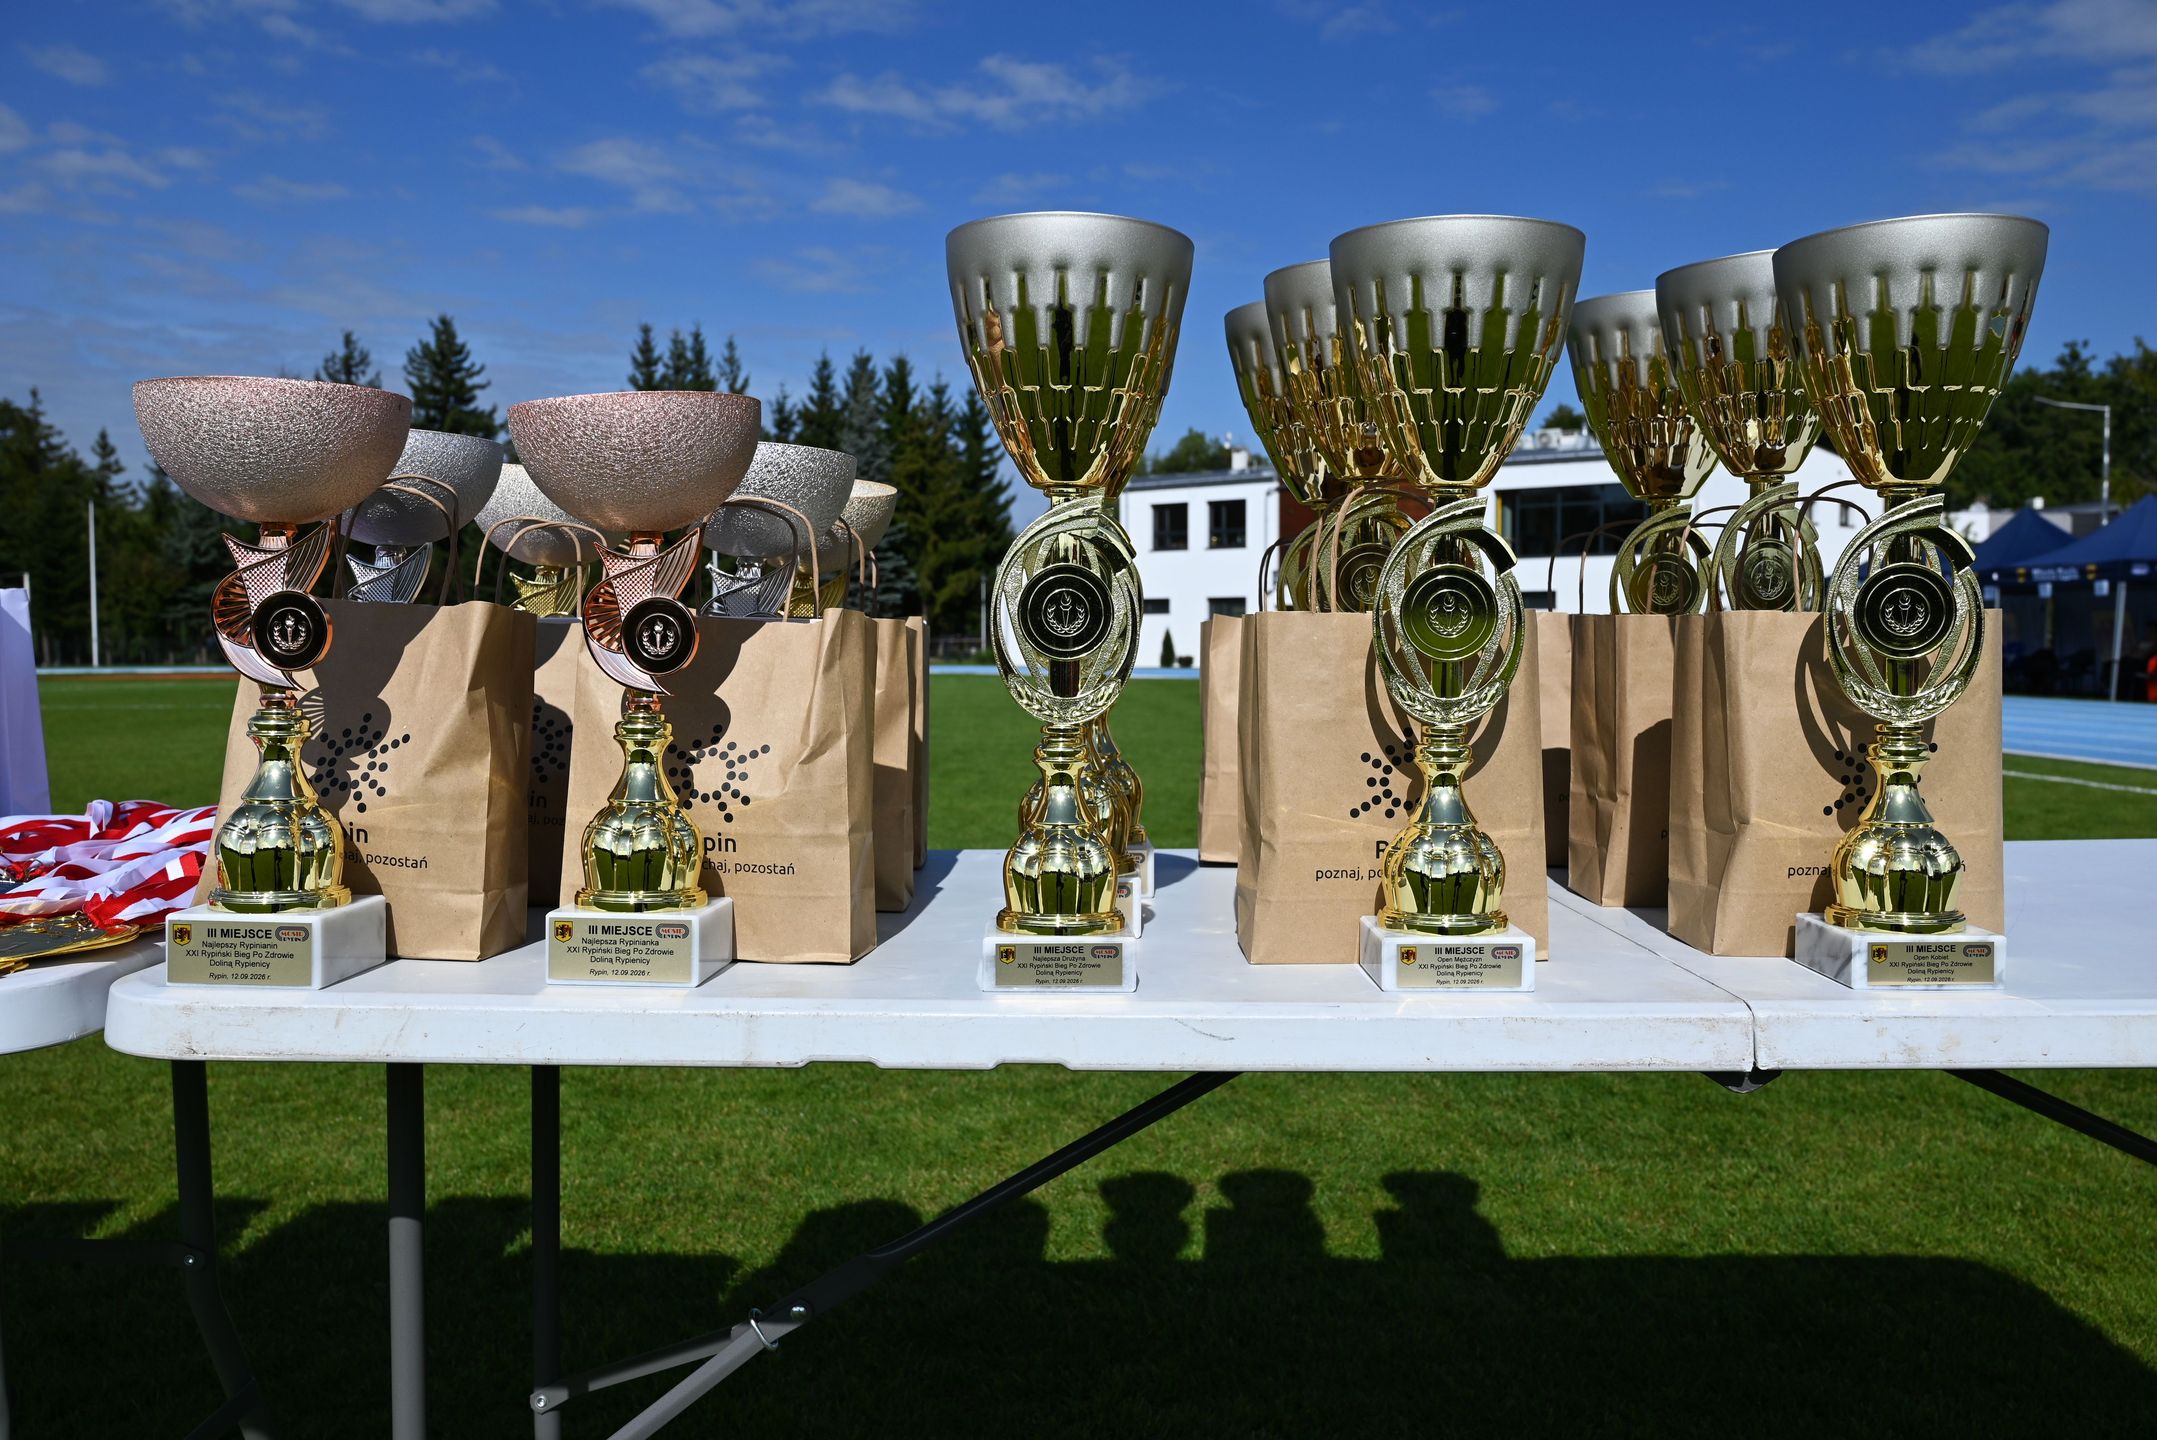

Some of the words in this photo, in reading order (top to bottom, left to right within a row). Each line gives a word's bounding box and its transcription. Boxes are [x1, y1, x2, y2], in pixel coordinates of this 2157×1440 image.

[366, 853, 428, 869] pozostań
[734, 863, 795, 876] pozostań
[1315, 866, 1364, 882] poznaj,
[207, 928, 217, 938] III
[221, 928, 272, 939] MIEJSCE
[588, 925, 597, 934] III
[602, 925, 652, 936] MIEJSCE
[202, 941, 237, 950] Najlepszy
[240, 942, 278, 950] Rypinianin
[582, 938, 617, 946] Najlepsza
[620, 939, 659, 947] Rypinianka
[582, 947, 612, 955] Rypiński
[615, 947, 630, 956] Bieg
[1445, 947, 1484, 955] MIEJSCE
[1916, 945, 1956, 953] MIEJSCE
[201, 950, 232, 958] Rypiński
[234, 951, 250, 959] Bieg
[265, 951, 294, 959] Zdrowie
[209, 960, 233, 968] Doliną
[235, 960, 270, 969] Rypienicy
[590, 956, 613, 964] Doliną
[615, 957, 650, 965] Rypienicy
